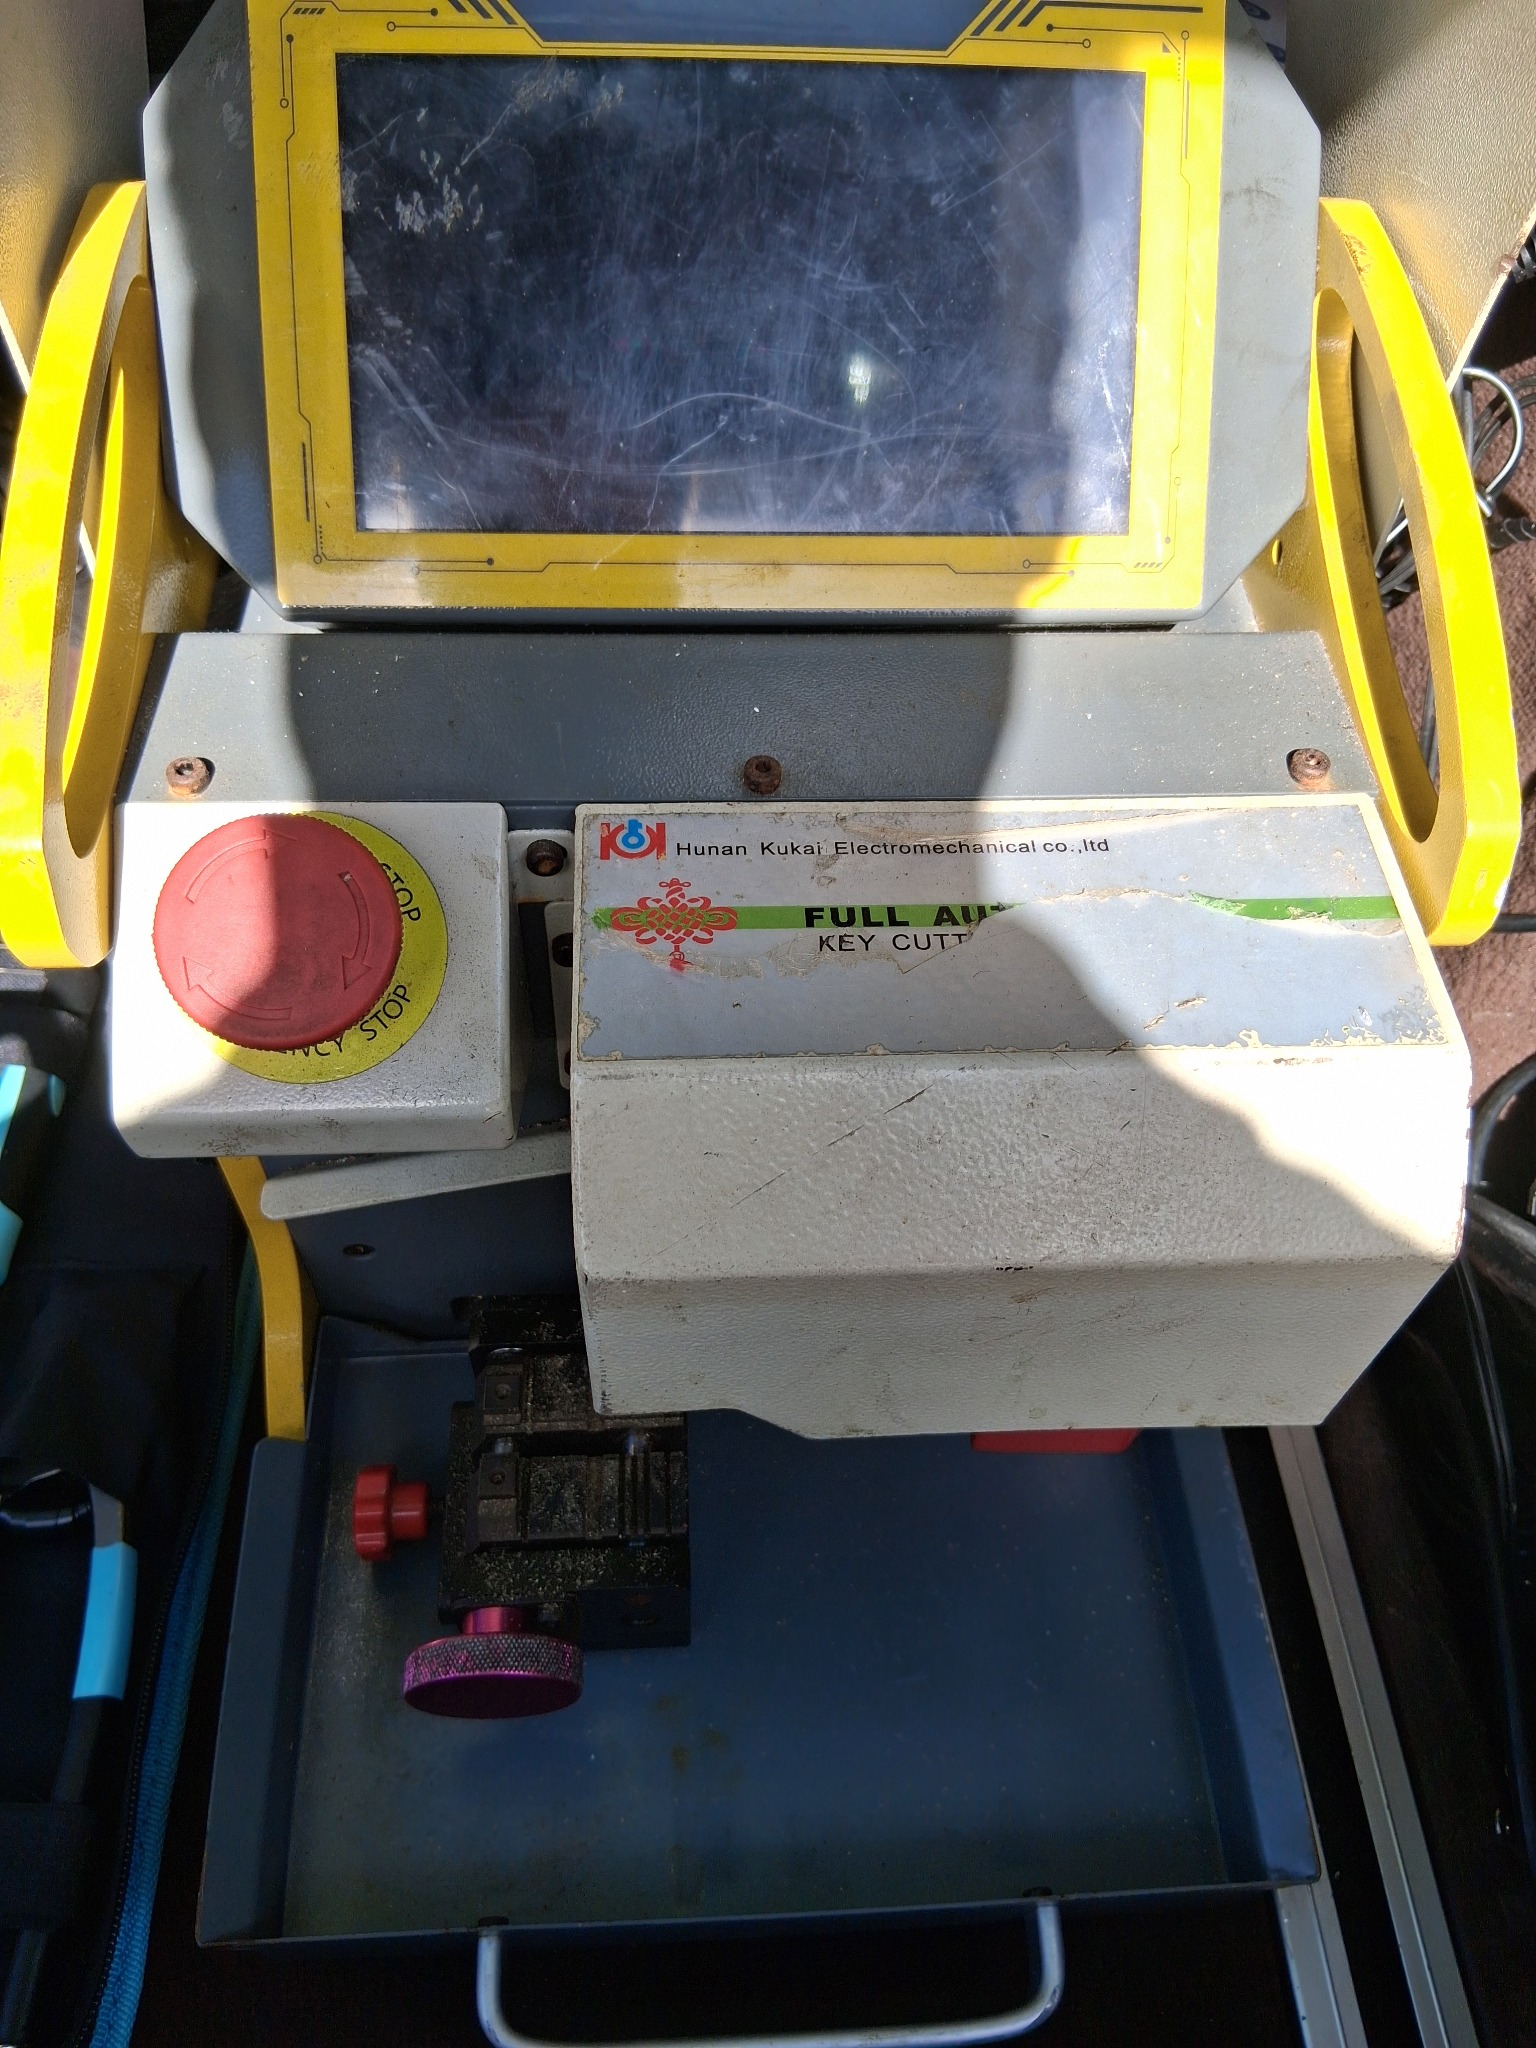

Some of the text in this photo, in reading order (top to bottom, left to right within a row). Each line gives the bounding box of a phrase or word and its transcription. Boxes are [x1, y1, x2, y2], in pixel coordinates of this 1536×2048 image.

[676, 842, 747, 856] Hunan
[760, 841, 821, 855] Kukai
[834, 840, 1036, 856] Electromechanical
[804, 906, 910, 928] FULL
[818, 934, 876, 952] KEY
[359, 984, 411, 1041] STOP
